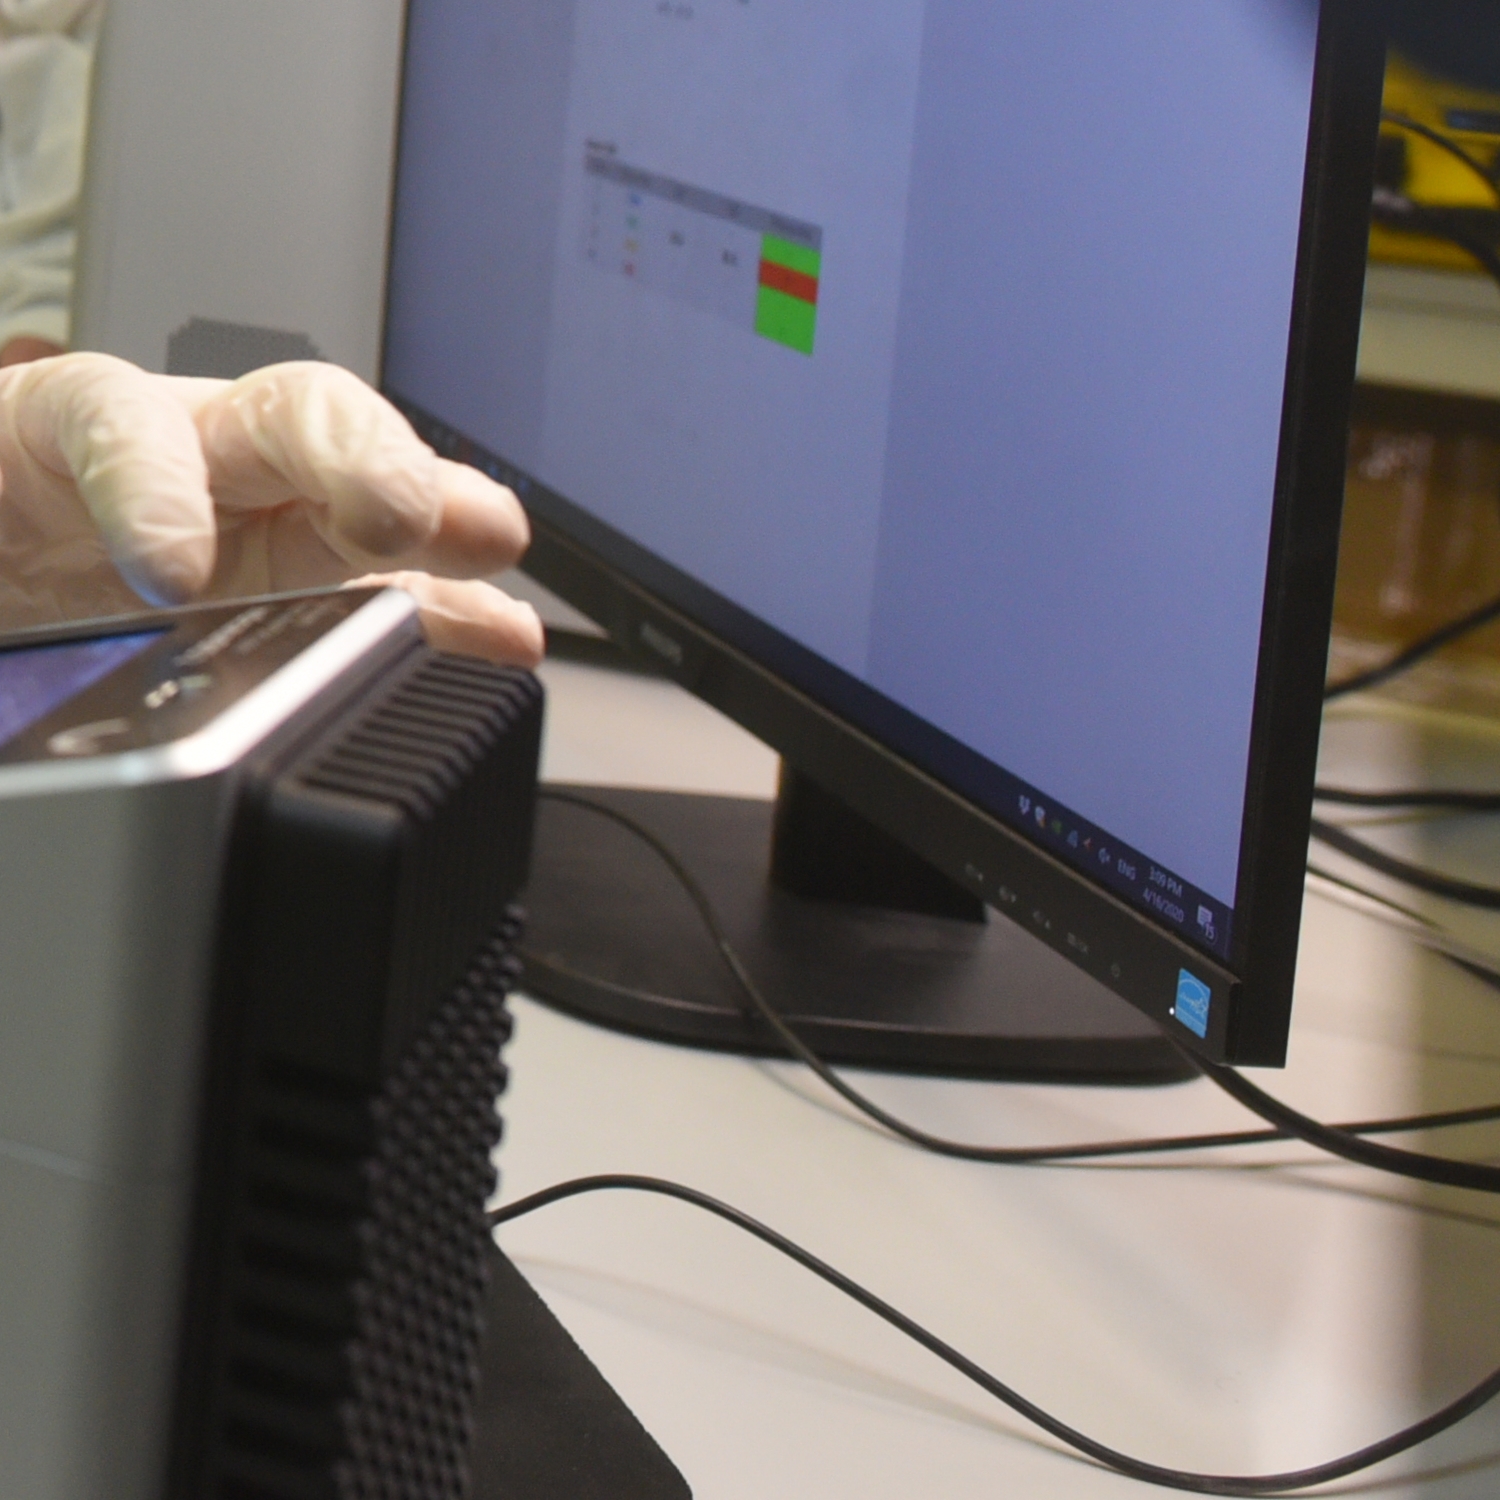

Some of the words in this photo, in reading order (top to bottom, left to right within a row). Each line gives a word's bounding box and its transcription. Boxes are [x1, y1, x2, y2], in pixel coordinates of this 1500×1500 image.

[1117, 858, 1136, 881] ENG
[1149, 866, 1167, 888] 3:09
[1167, 877, 1183, 898] PM
